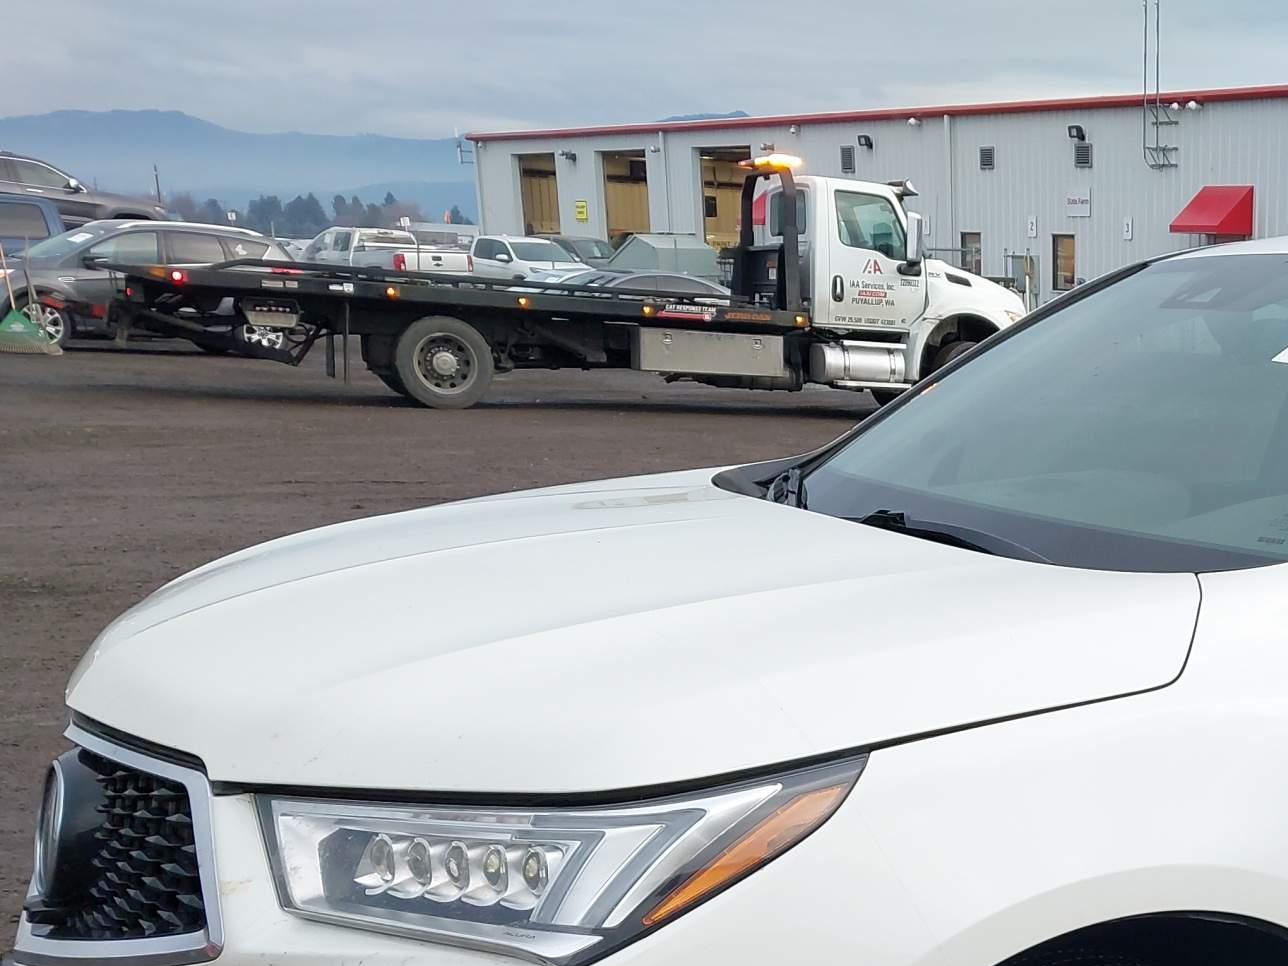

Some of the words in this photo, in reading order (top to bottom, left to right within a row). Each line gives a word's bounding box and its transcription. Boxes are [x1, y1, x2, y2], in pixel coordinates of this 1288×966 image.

[1029, 221, 1034, 232] 2
[849, 280, 860, 288] IAA
[885, 298, 895, 307] WA
[676, 304, 702, 312] RESPONSE
[702, 305, 717, 313] TEAM
